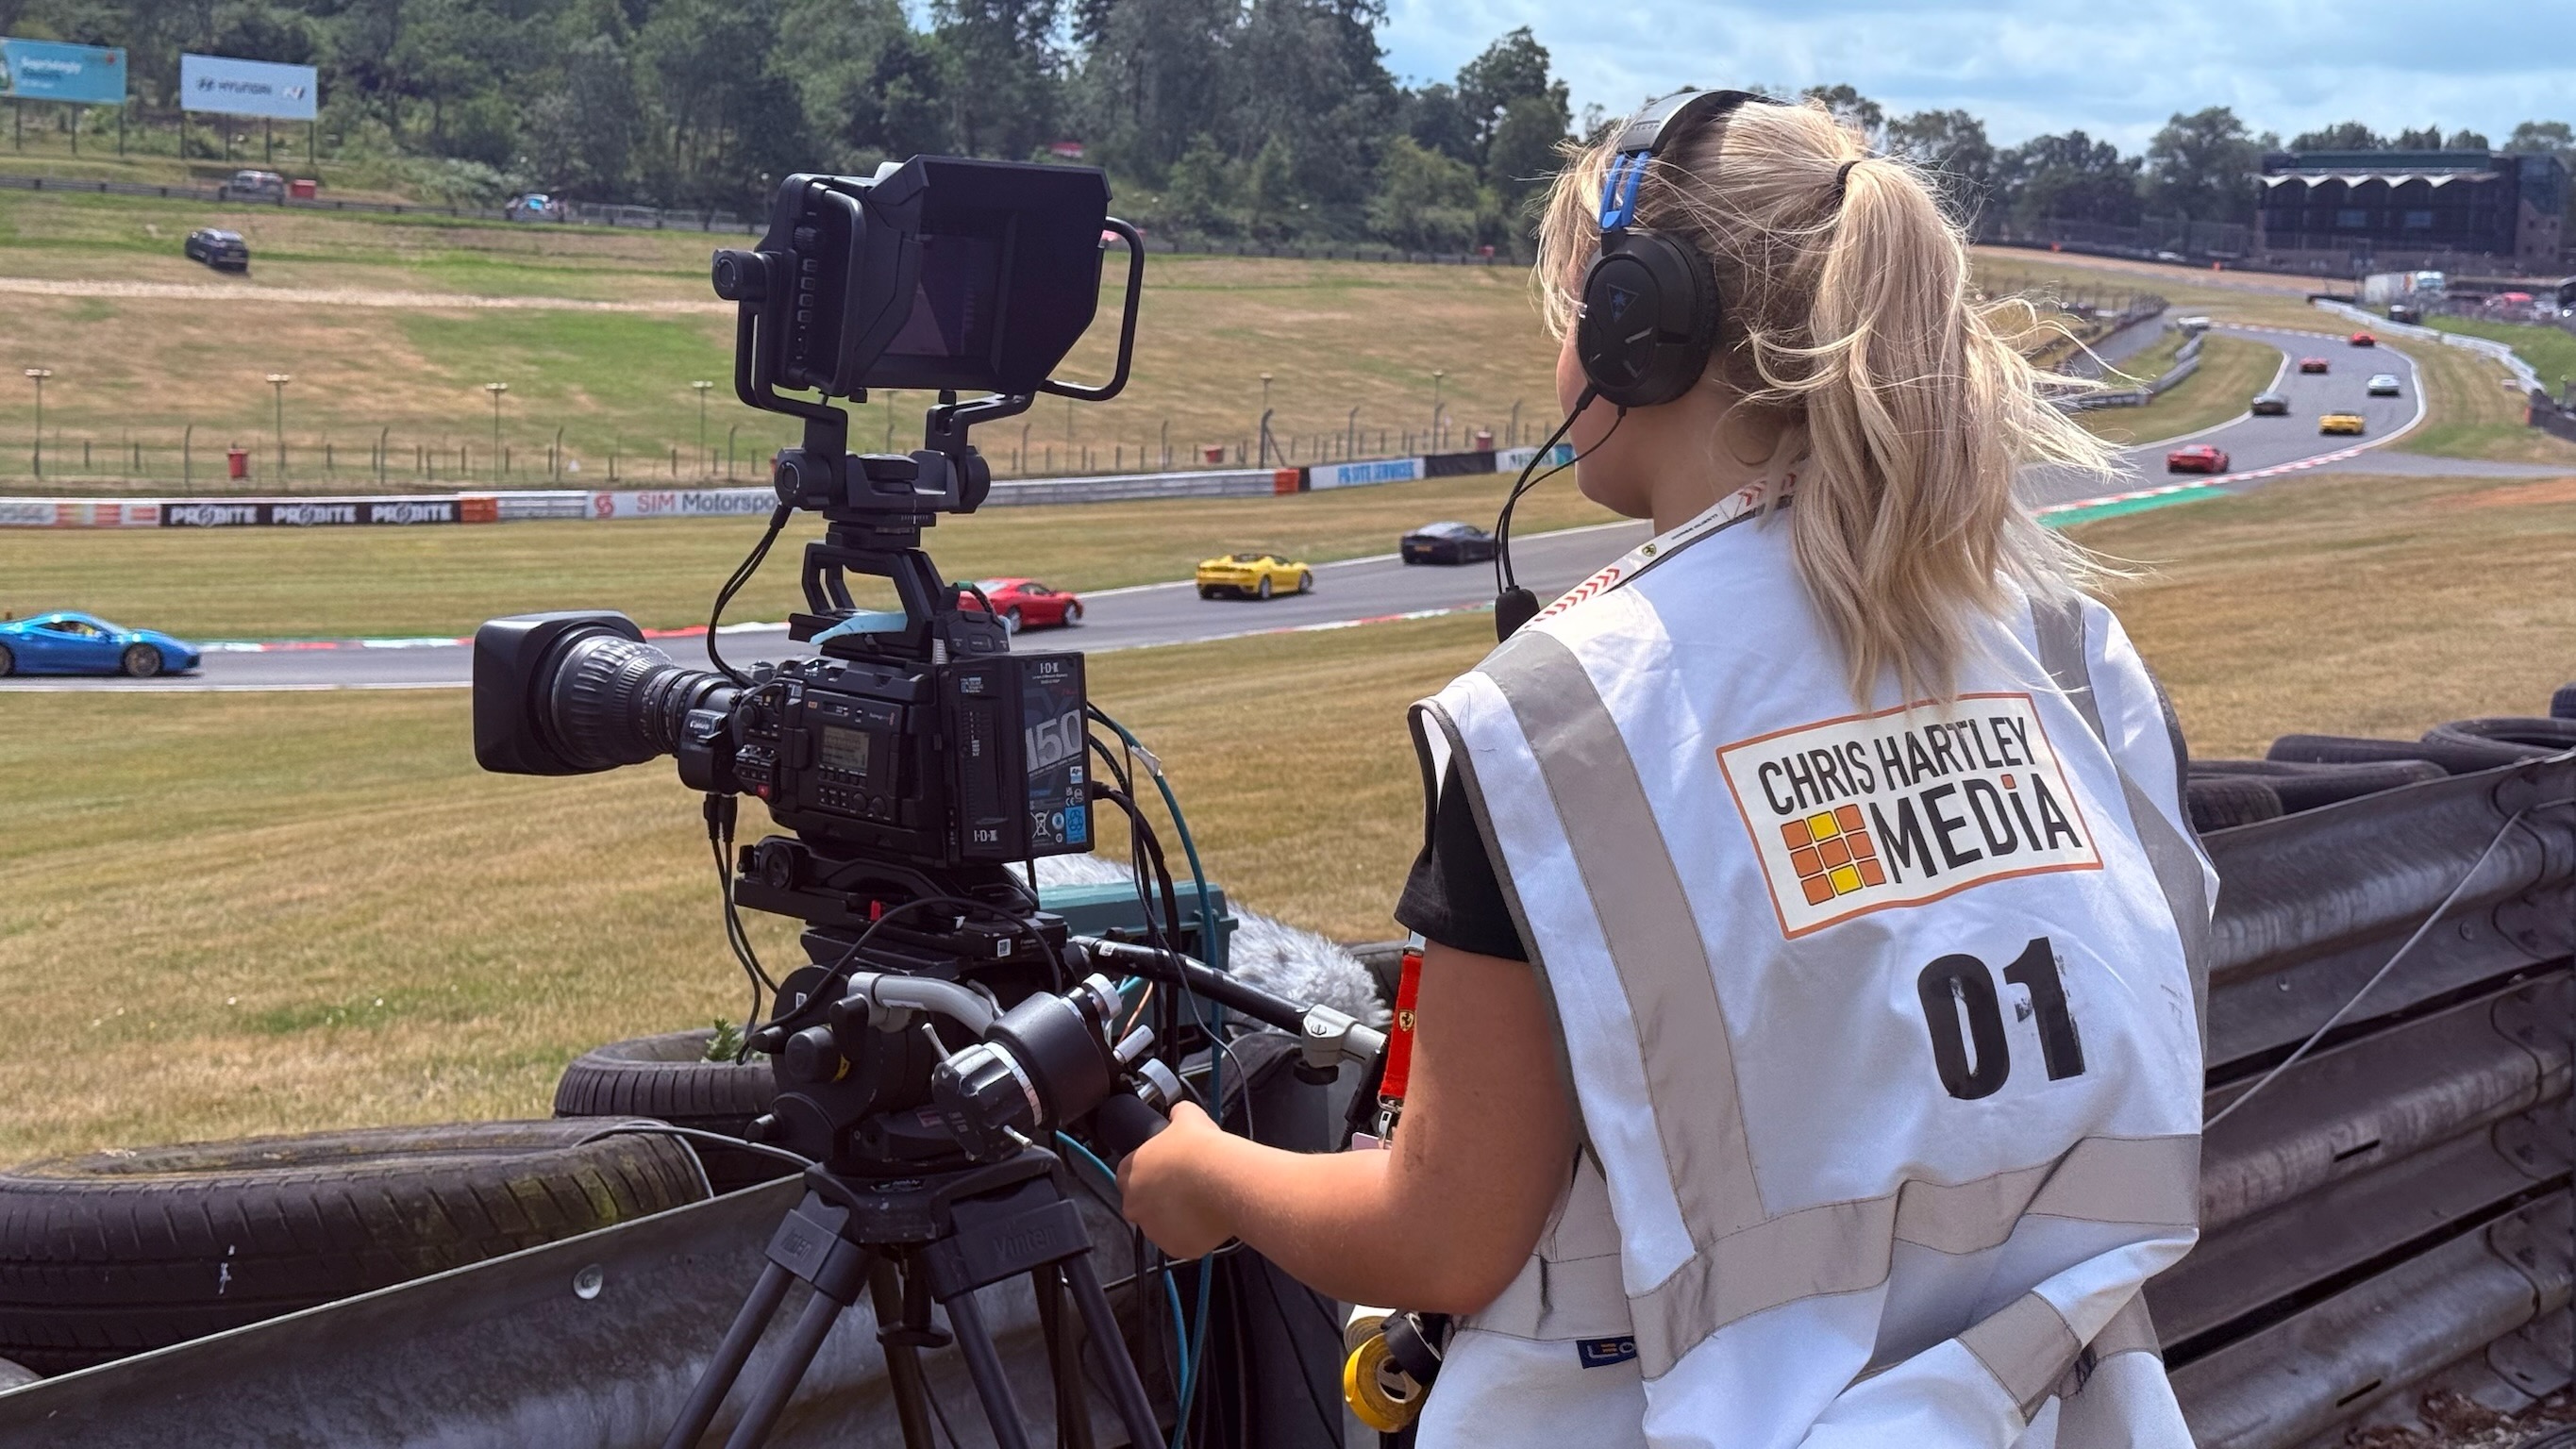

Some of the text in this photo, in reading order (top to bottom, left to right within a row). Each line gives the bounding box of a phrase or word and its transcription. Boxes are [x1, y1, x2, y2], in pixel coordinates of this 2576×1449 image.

[636, 491, 778, 516] SIM Motorspo
[1025, 708, 1083, 774] 150
[1757, 716, 2036, 815] CHRIS HARTLEY
[1917, 936, 2086, 1100] 01
